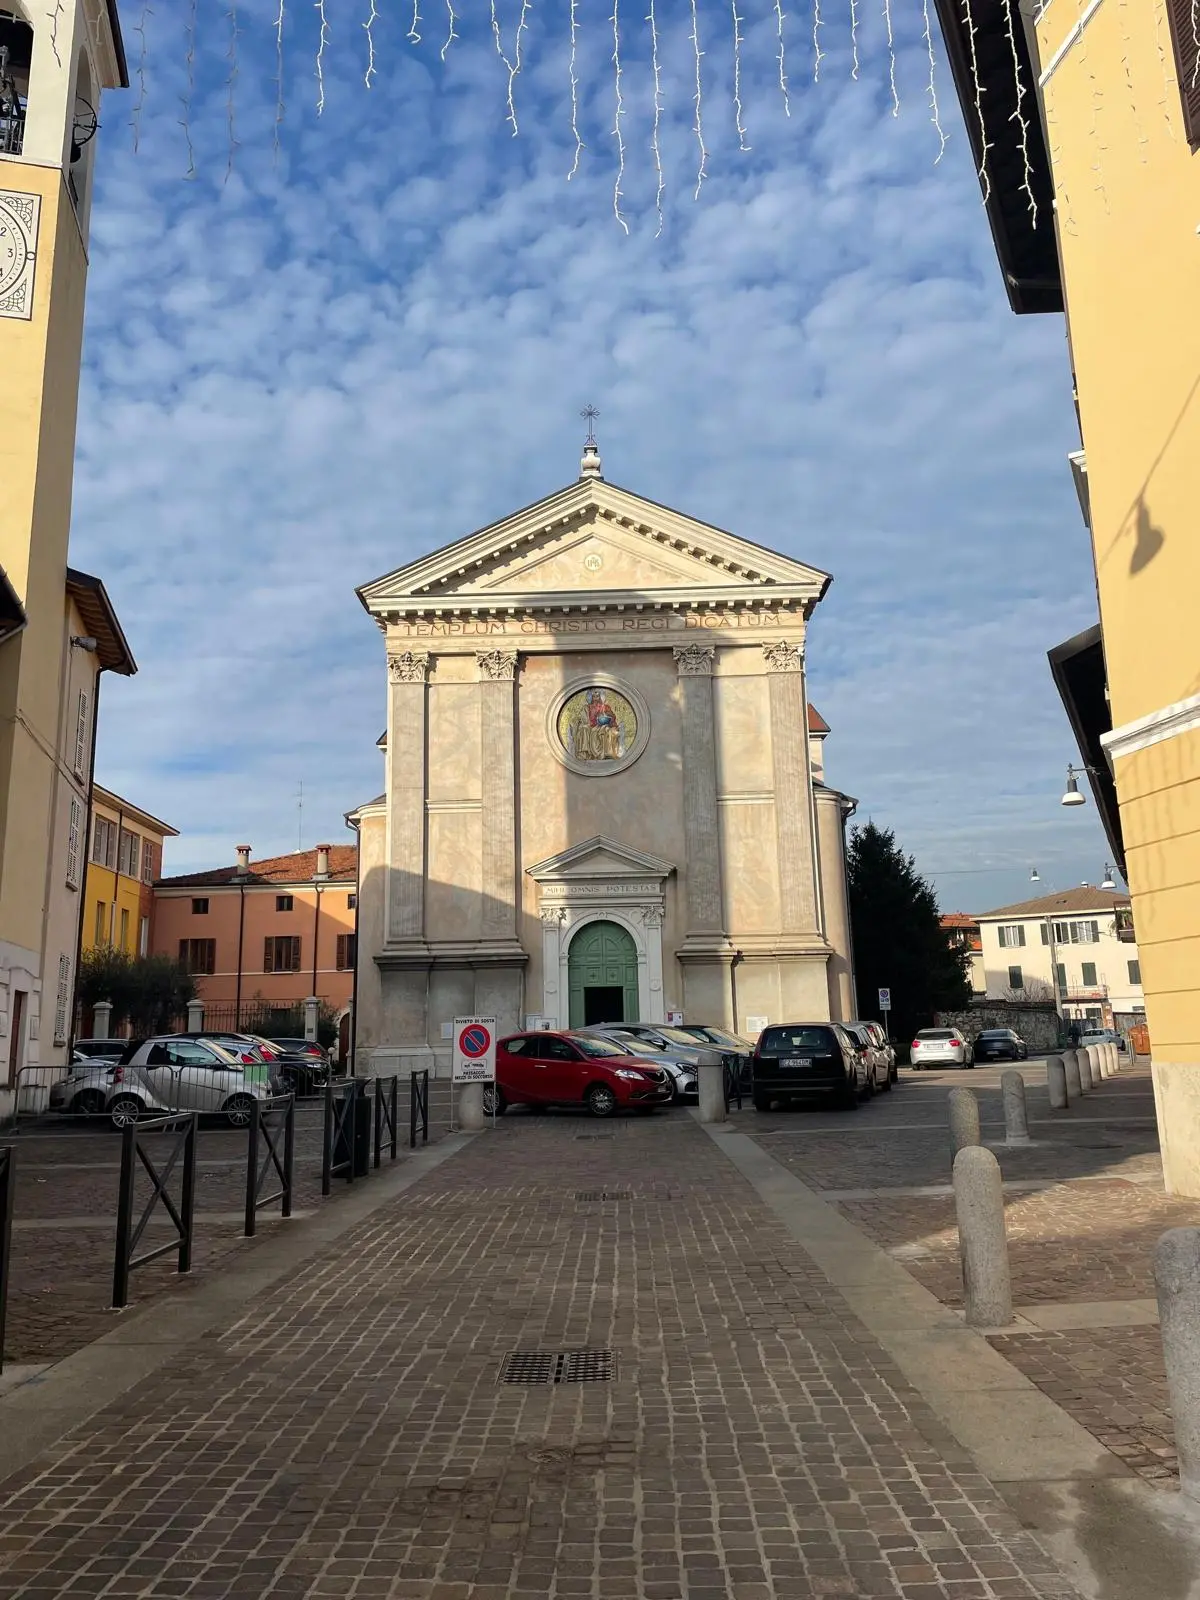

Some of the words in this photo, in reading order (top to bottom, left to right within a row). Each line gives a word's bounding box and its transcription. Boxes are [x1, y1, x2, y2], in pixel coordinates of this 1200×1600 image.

[7, 248, 13, 258] 3
[406, 622, 507, 636] TEMPLUM
[520, 619, 606, 633] CHRISTO
[622, 617, 670, 630] REGI
[685, 614, 781, 629] DICATUM
[606, 884, 657, 893] POTESTAS
